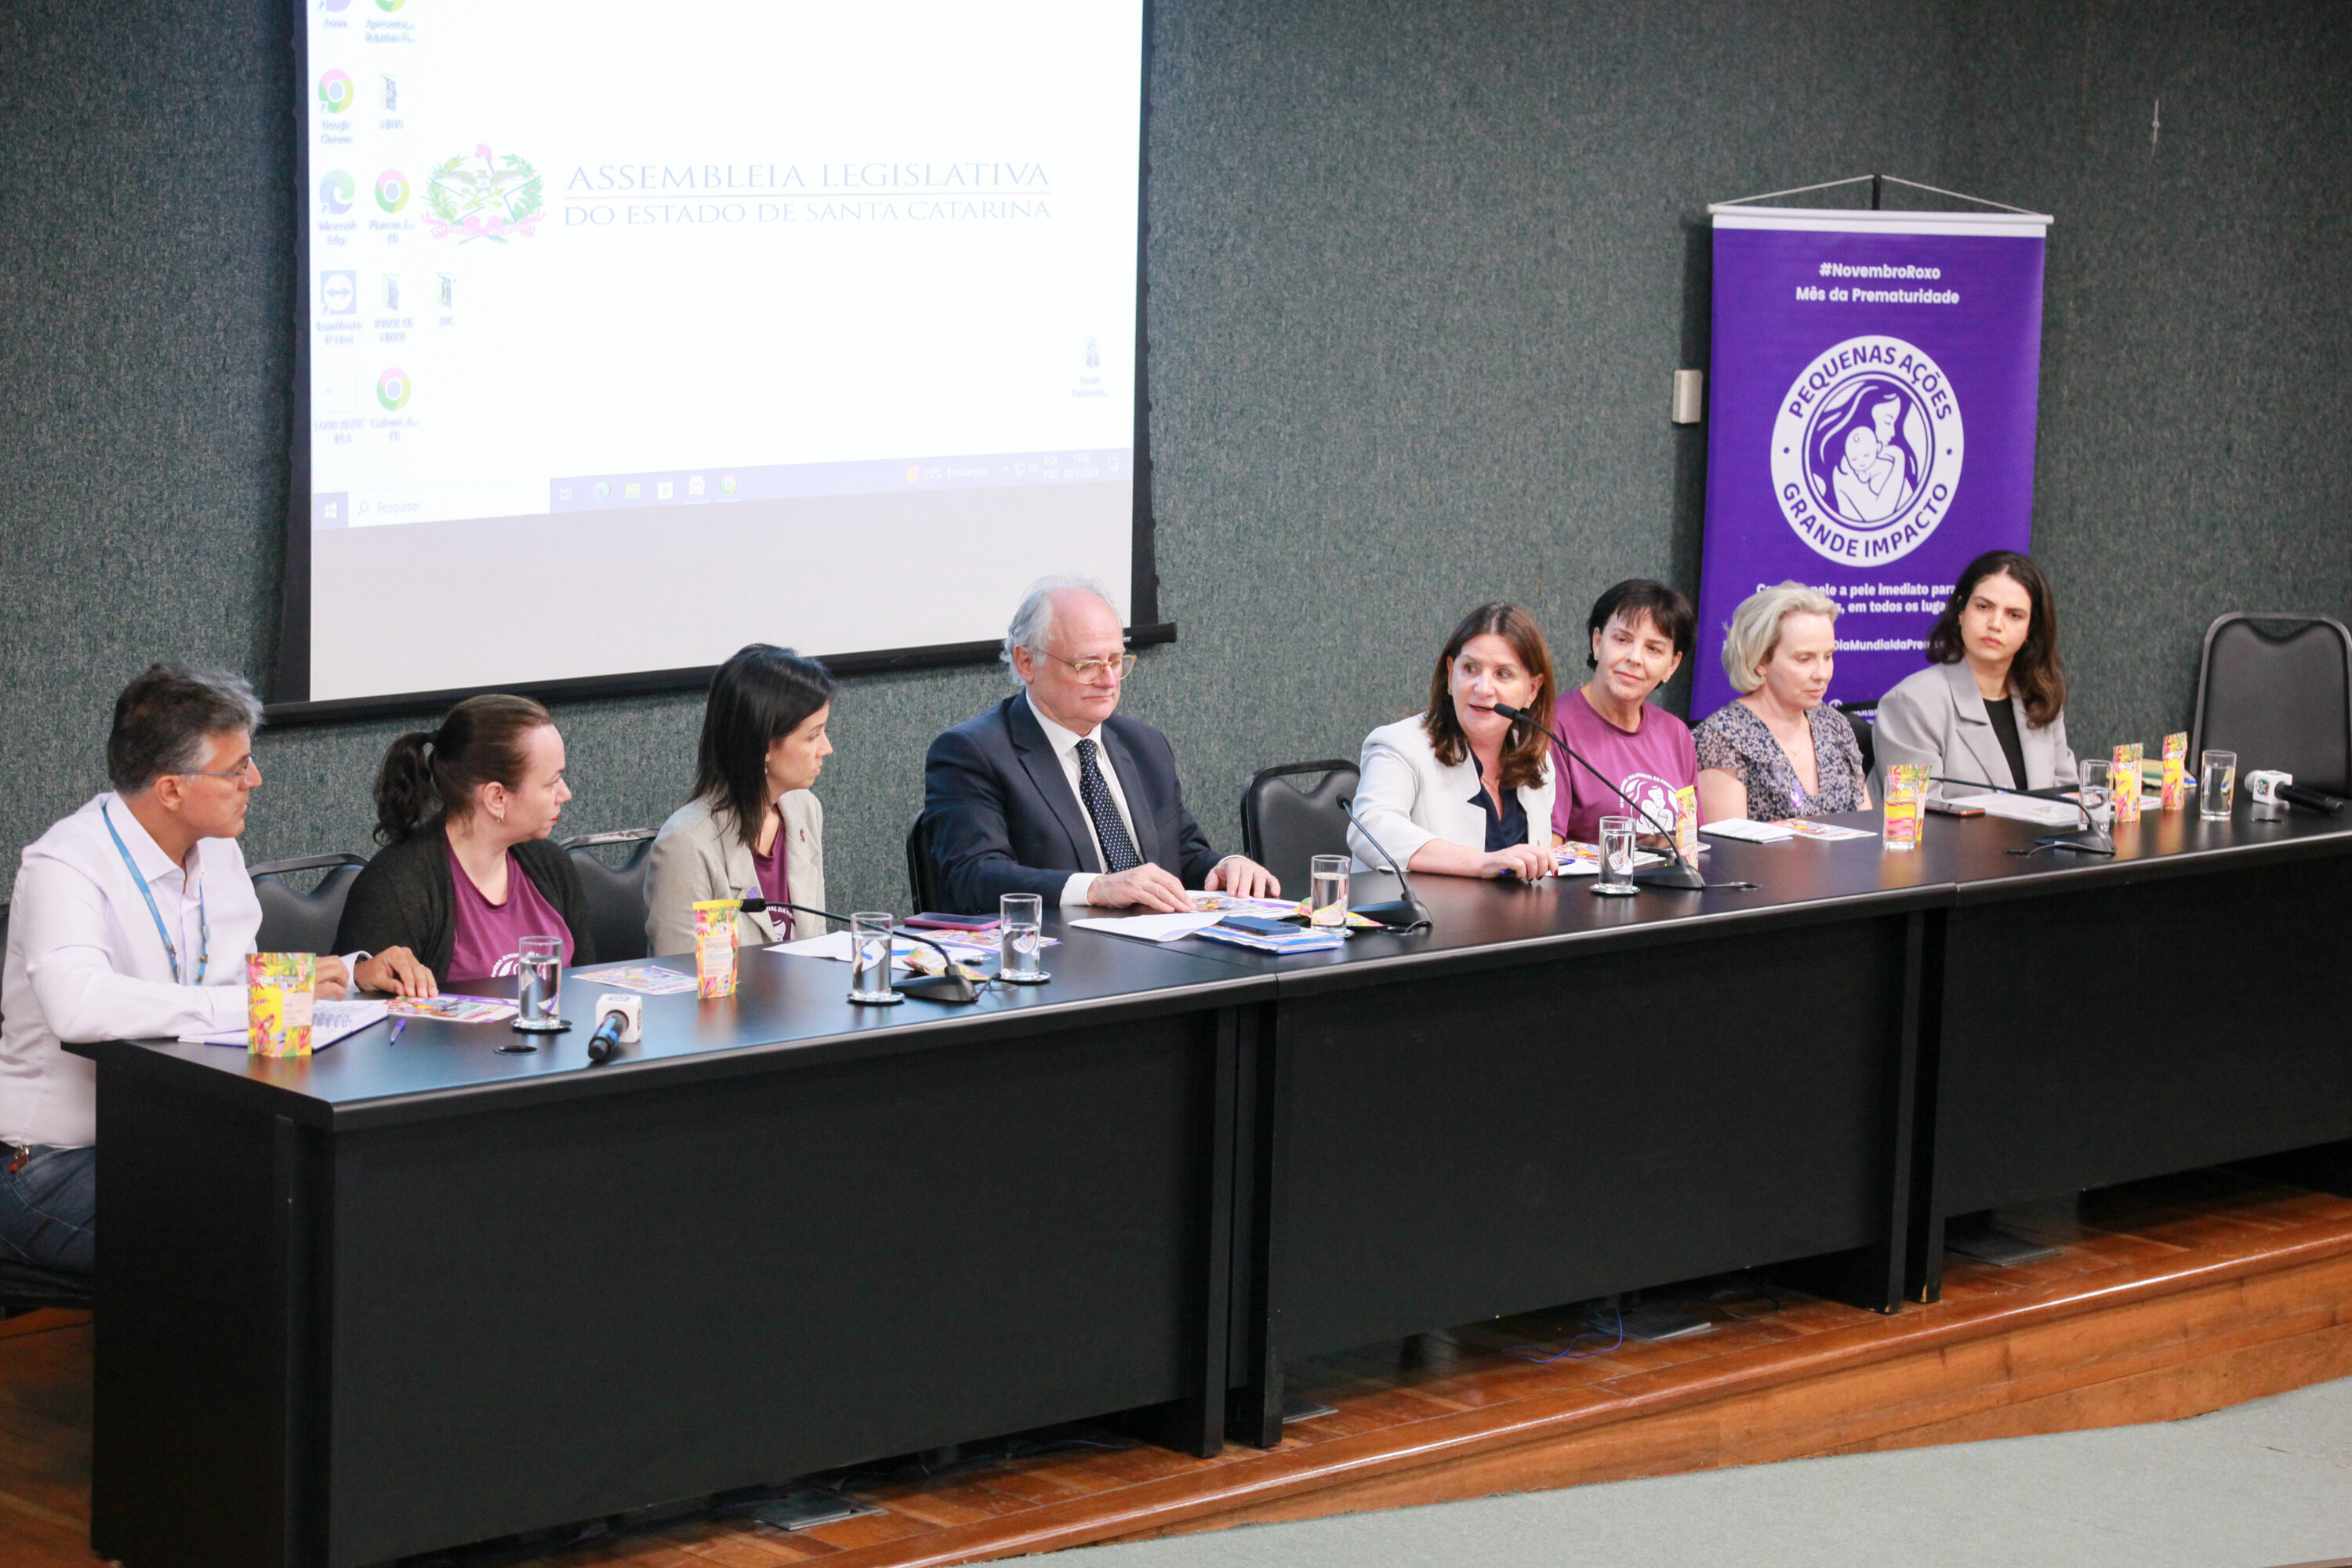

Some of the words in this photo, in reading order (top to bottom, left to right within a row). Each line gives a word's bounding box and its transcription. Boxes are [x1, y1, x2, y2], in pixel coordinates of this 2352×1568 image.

[565, 165, 807, 190] ASSEMBLEIA
[822, 163, 1051, 187] LEGISLATIVA
[564, 206, 615, 226] DO
[627, 204, 746, 224] ESTADO
[758, 203, 795, 222] DE
[806, 202, 899, 222] SANTA
[908, 201, 1051, 220] CATARINA
[1819, 262, 1941, 280] #NovembroRoxo
[1795, 287, 1826, 302] Mês
[1828, 287, 1849, 302] da
[1851, 288, 1960, 304] Prematuridade
[1788, 344, 1897, 419] PEQUENAS
[1899, 353, 1952, 421] AÇÕES
[377, 500, 422, 516] Pesquisar
[1782, 481, 1859, 557] GRANDE
[1864, 482, 1949, 558] IMPACTO
[1839, 586, 1847, 596] a
[1849, 583, 1876, 599] pele
[1878, 583, 1929, 596] imediato
[1847, 602, 1867, 612] em
[1869, 600, 1903, 612] todos
[1904, 602, 1918, 612] os
[1921, 599, 1947, 615] luga
